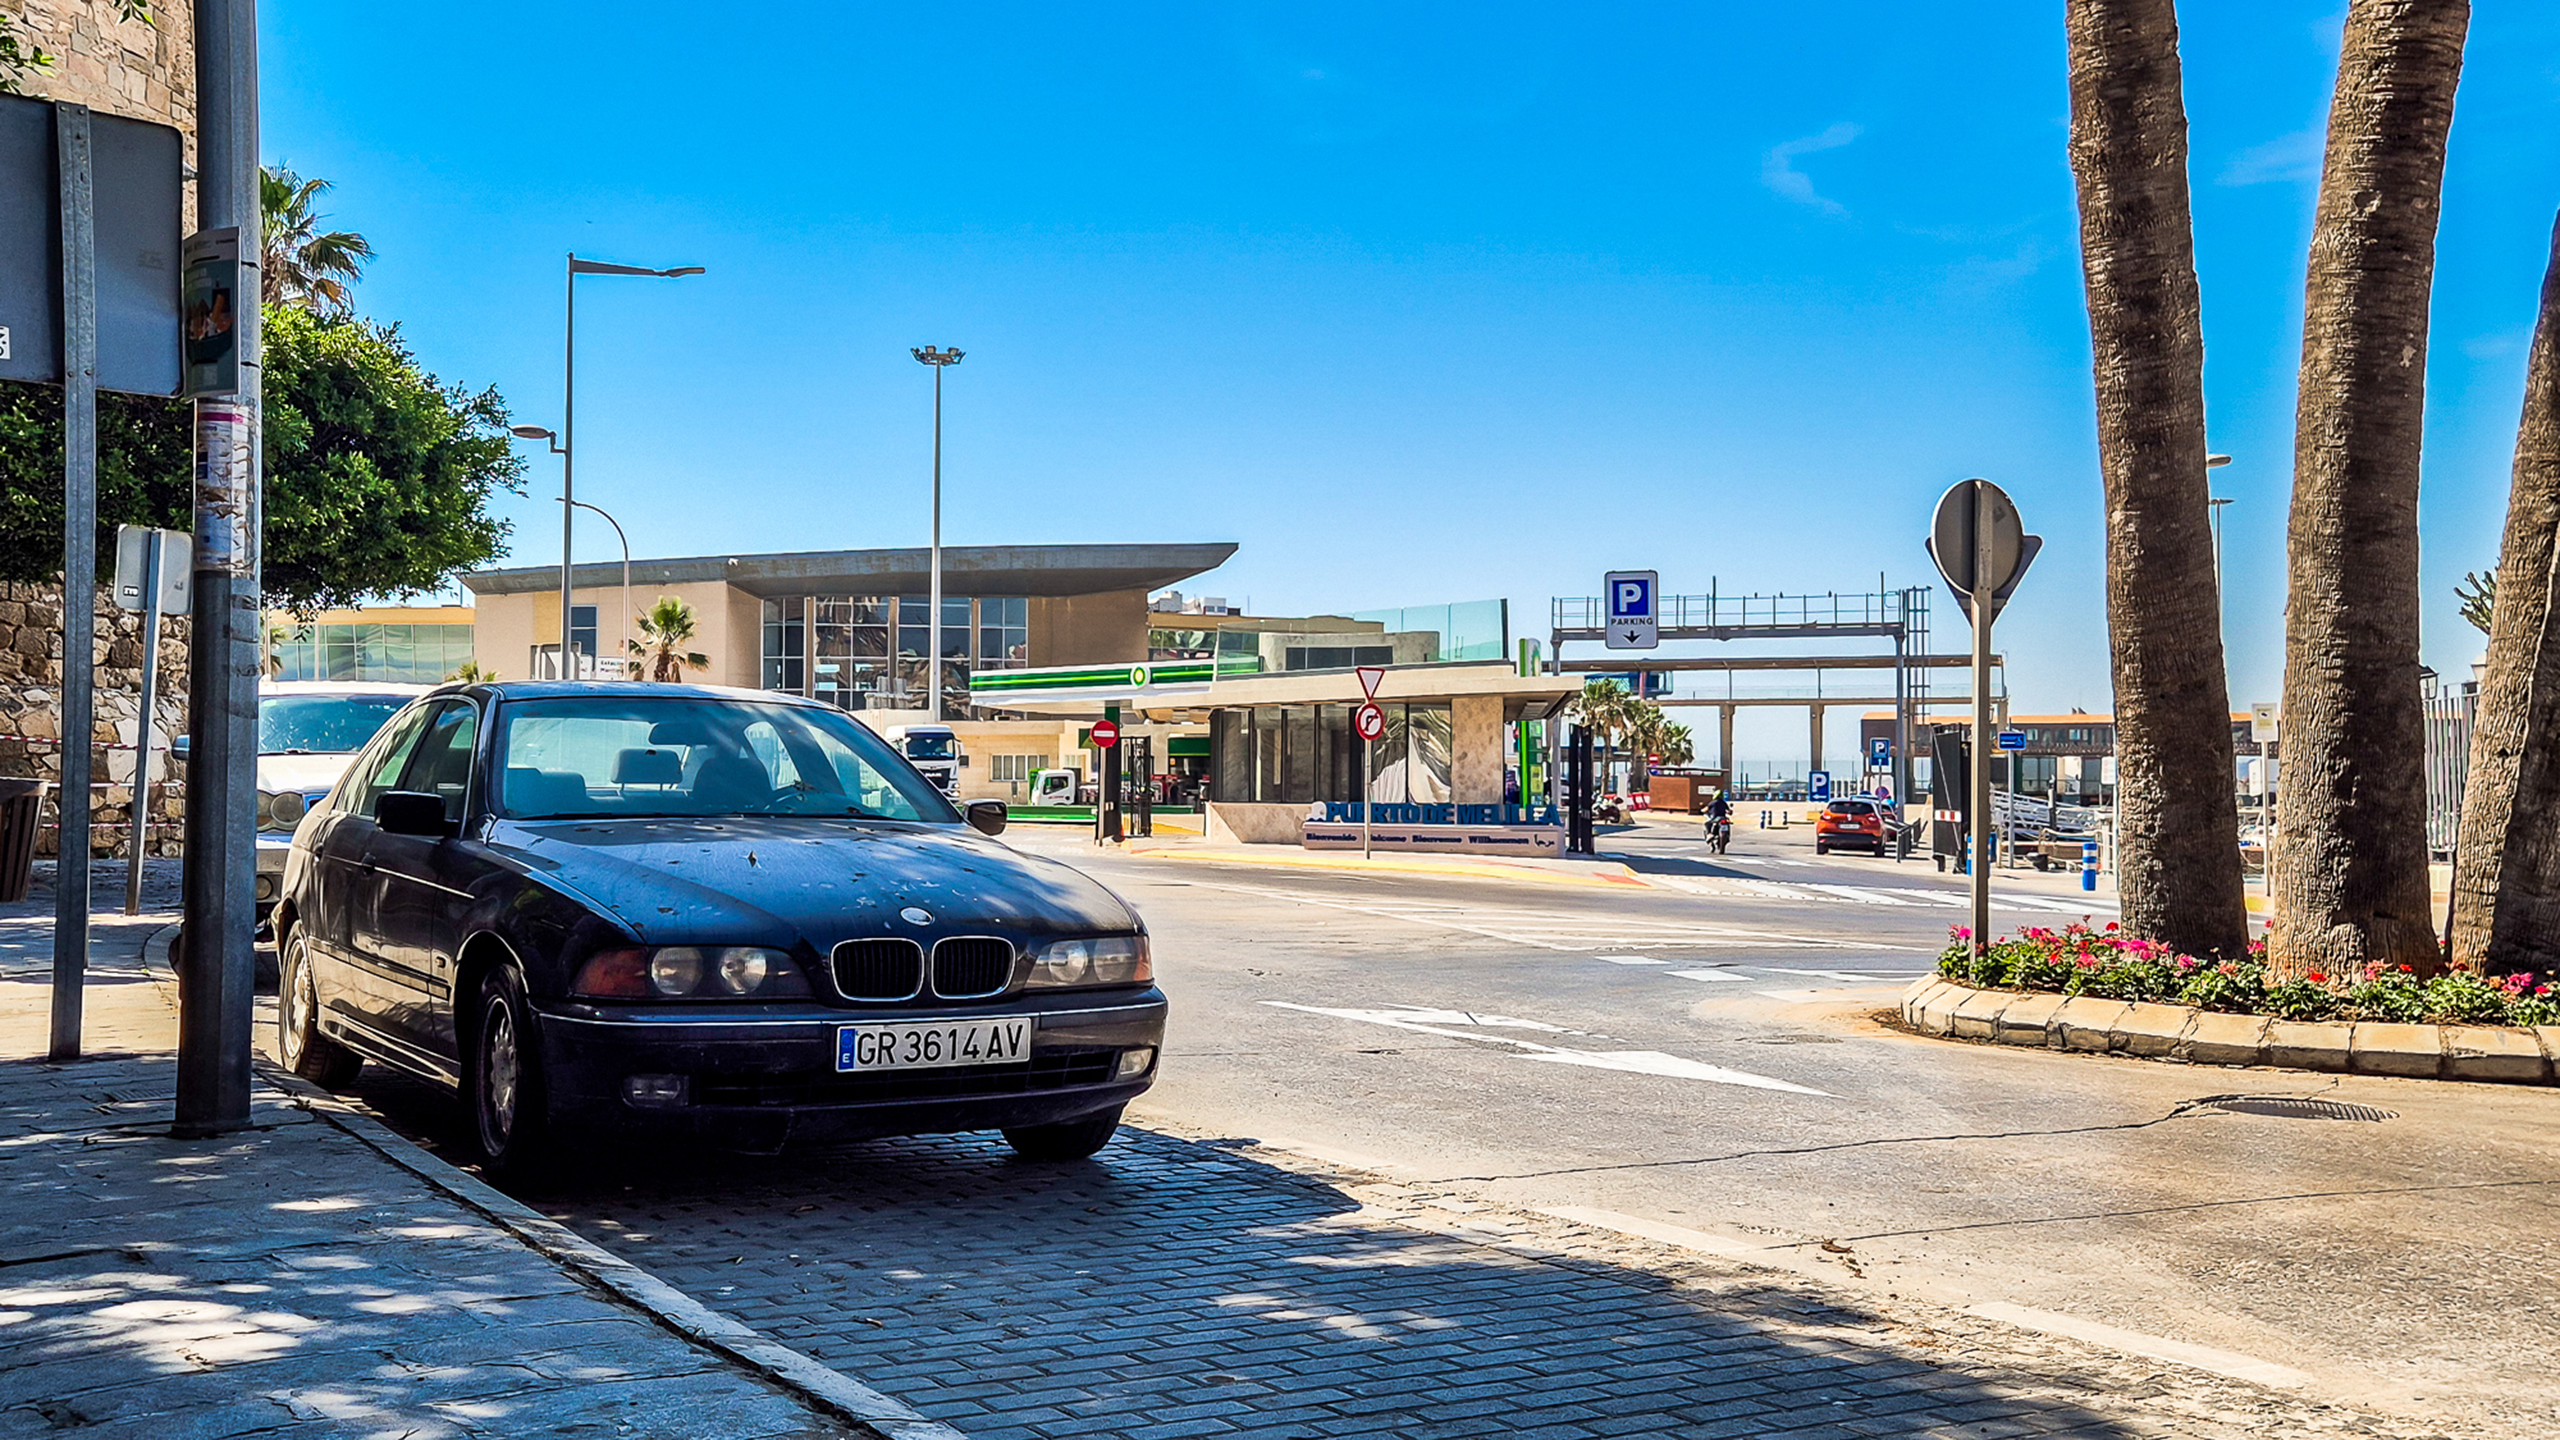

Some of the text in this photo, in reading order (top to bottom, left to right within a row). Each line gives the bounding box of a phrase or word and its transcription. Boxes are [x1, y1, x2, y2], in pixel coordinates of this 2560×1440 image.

[1618, 583, 1642, 612] P
[1611, 617, 1653, 626] PARKING
[1875, 741, 1885, 753] P
[1811, 773, 1827, 793] P
[1423, 803, 1455, 825] DE
[842, 1053, 850, 1063] E
